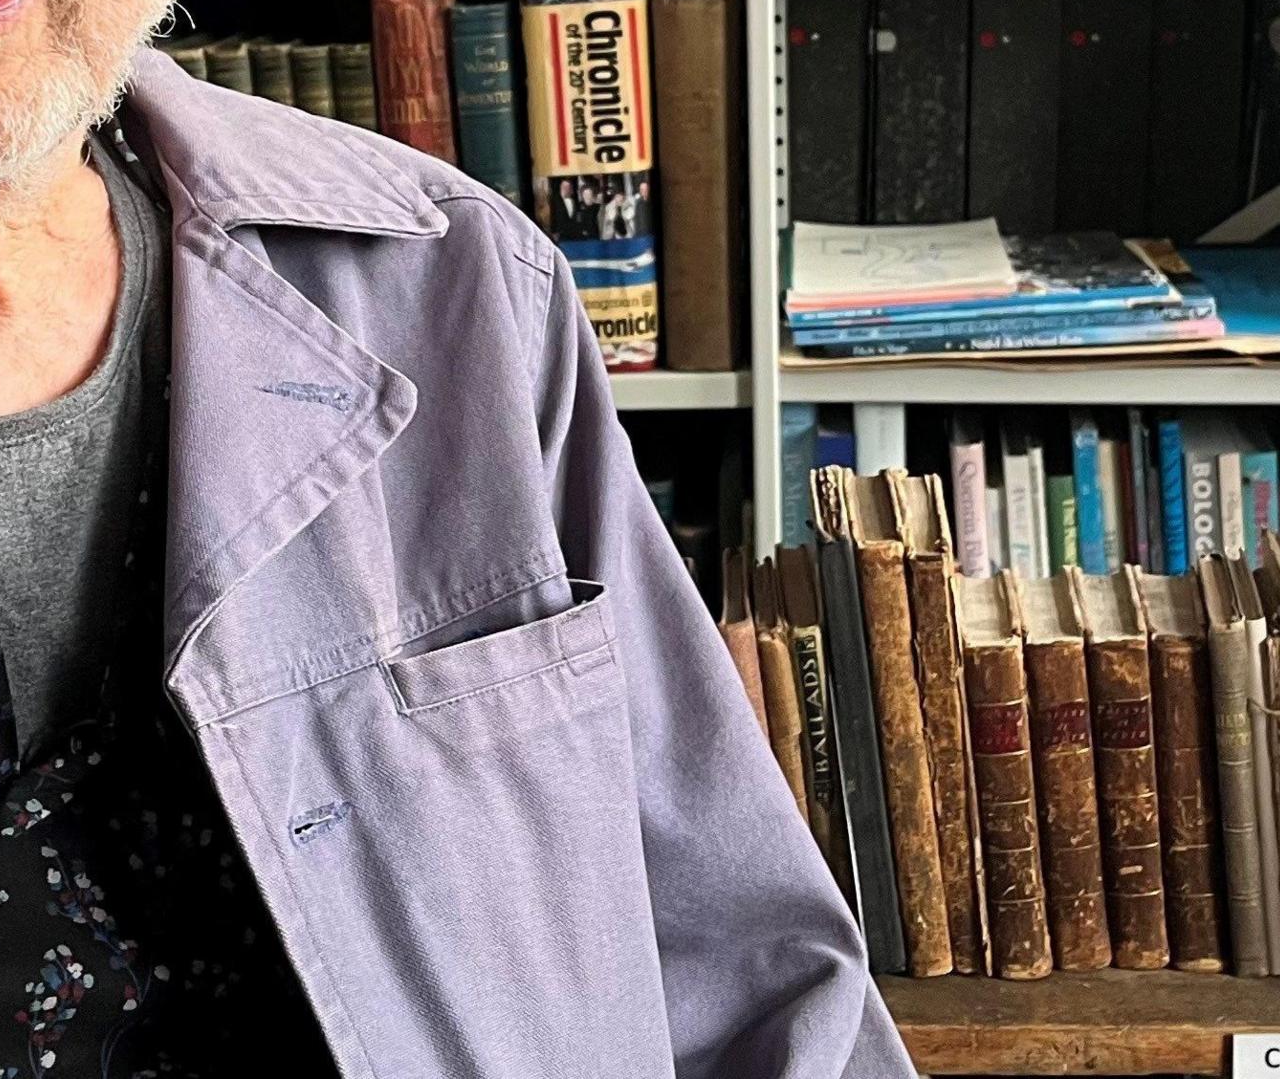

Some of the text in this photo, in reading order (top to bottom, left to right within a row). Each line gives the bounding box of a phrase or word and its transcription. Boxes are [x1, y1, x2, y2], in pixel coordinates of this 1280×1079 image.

[565, 23, 583, 40] of
[567, 42, 585, 68] the
[583, 9, 632, 166] Chronicle
[571, 98, 589, 156] Century
[594, 311, 657, 339] ronicle
[955, 459, 988, 577] Quentin Blak
[809, 656, 832, 775] BALLADS
